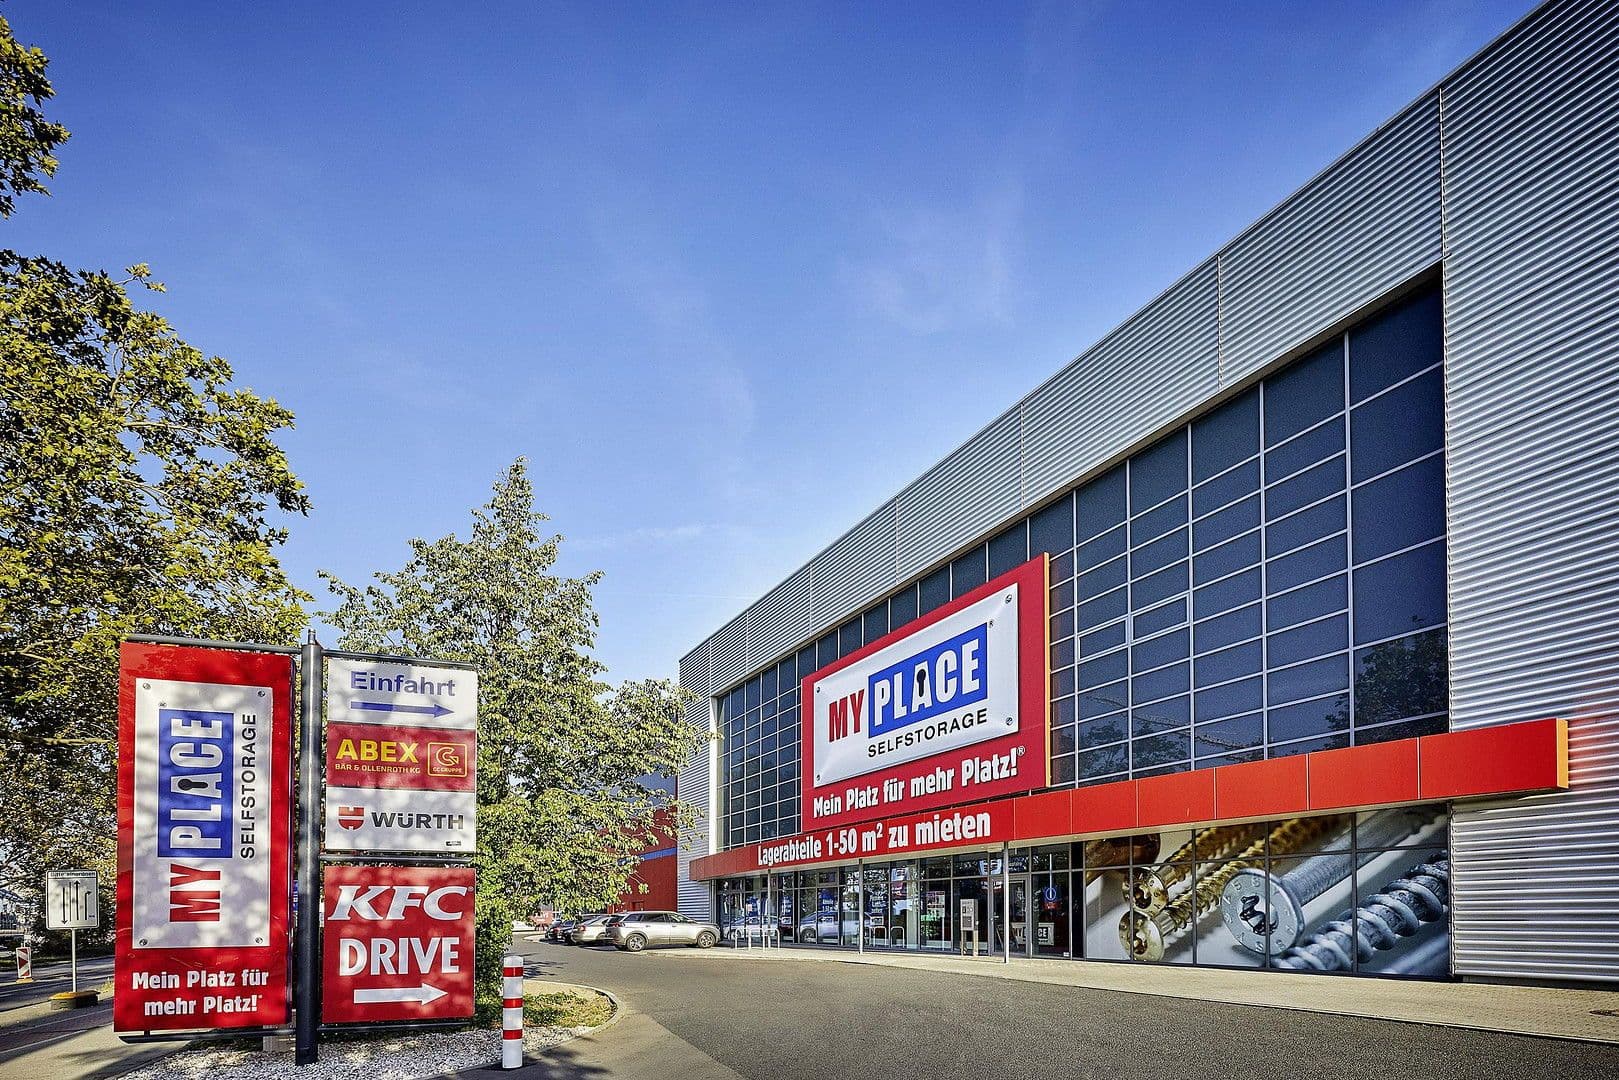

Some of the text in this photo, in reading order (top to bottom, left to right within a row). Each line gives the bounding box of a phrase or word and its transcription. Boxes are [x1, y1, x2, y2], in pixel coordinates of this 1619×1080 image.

[351, 671, 456, 697] Einfahrt
[829, 638, 980, 743] MY PLACE
[335, 738, 419, 764] ABEX
[867, 708, 988, 758] SELFSTORAGE
[240, 713, 257, 860] SELFSTORAGE
[335, 763, 352, 771] BÄR
[361, 765, 409, 774] OLLENROTH
[813, 794, 842, 819] Mein
[846, 785, 879, 811] Platz
[883, 779, 905, 804] für
[910, 766, 955, 798] mehr
[169, 718, 223, 923] MY PLACE
[371, 811, 464, 830] WÜRTH
[757, 835, 822, 867] Lagerabteile
[825, 828, 857, 856] 1-50
[888, 825, 909, 849] zu
[915, 812, 991, 846] mieten
[327, 885, 468, 921] KFC
[339, 937, 460, 977] DRIVE
[132, 969, 269, 990] Mein Platz für
[144, 994, 258, 1016] mehr Platz!
